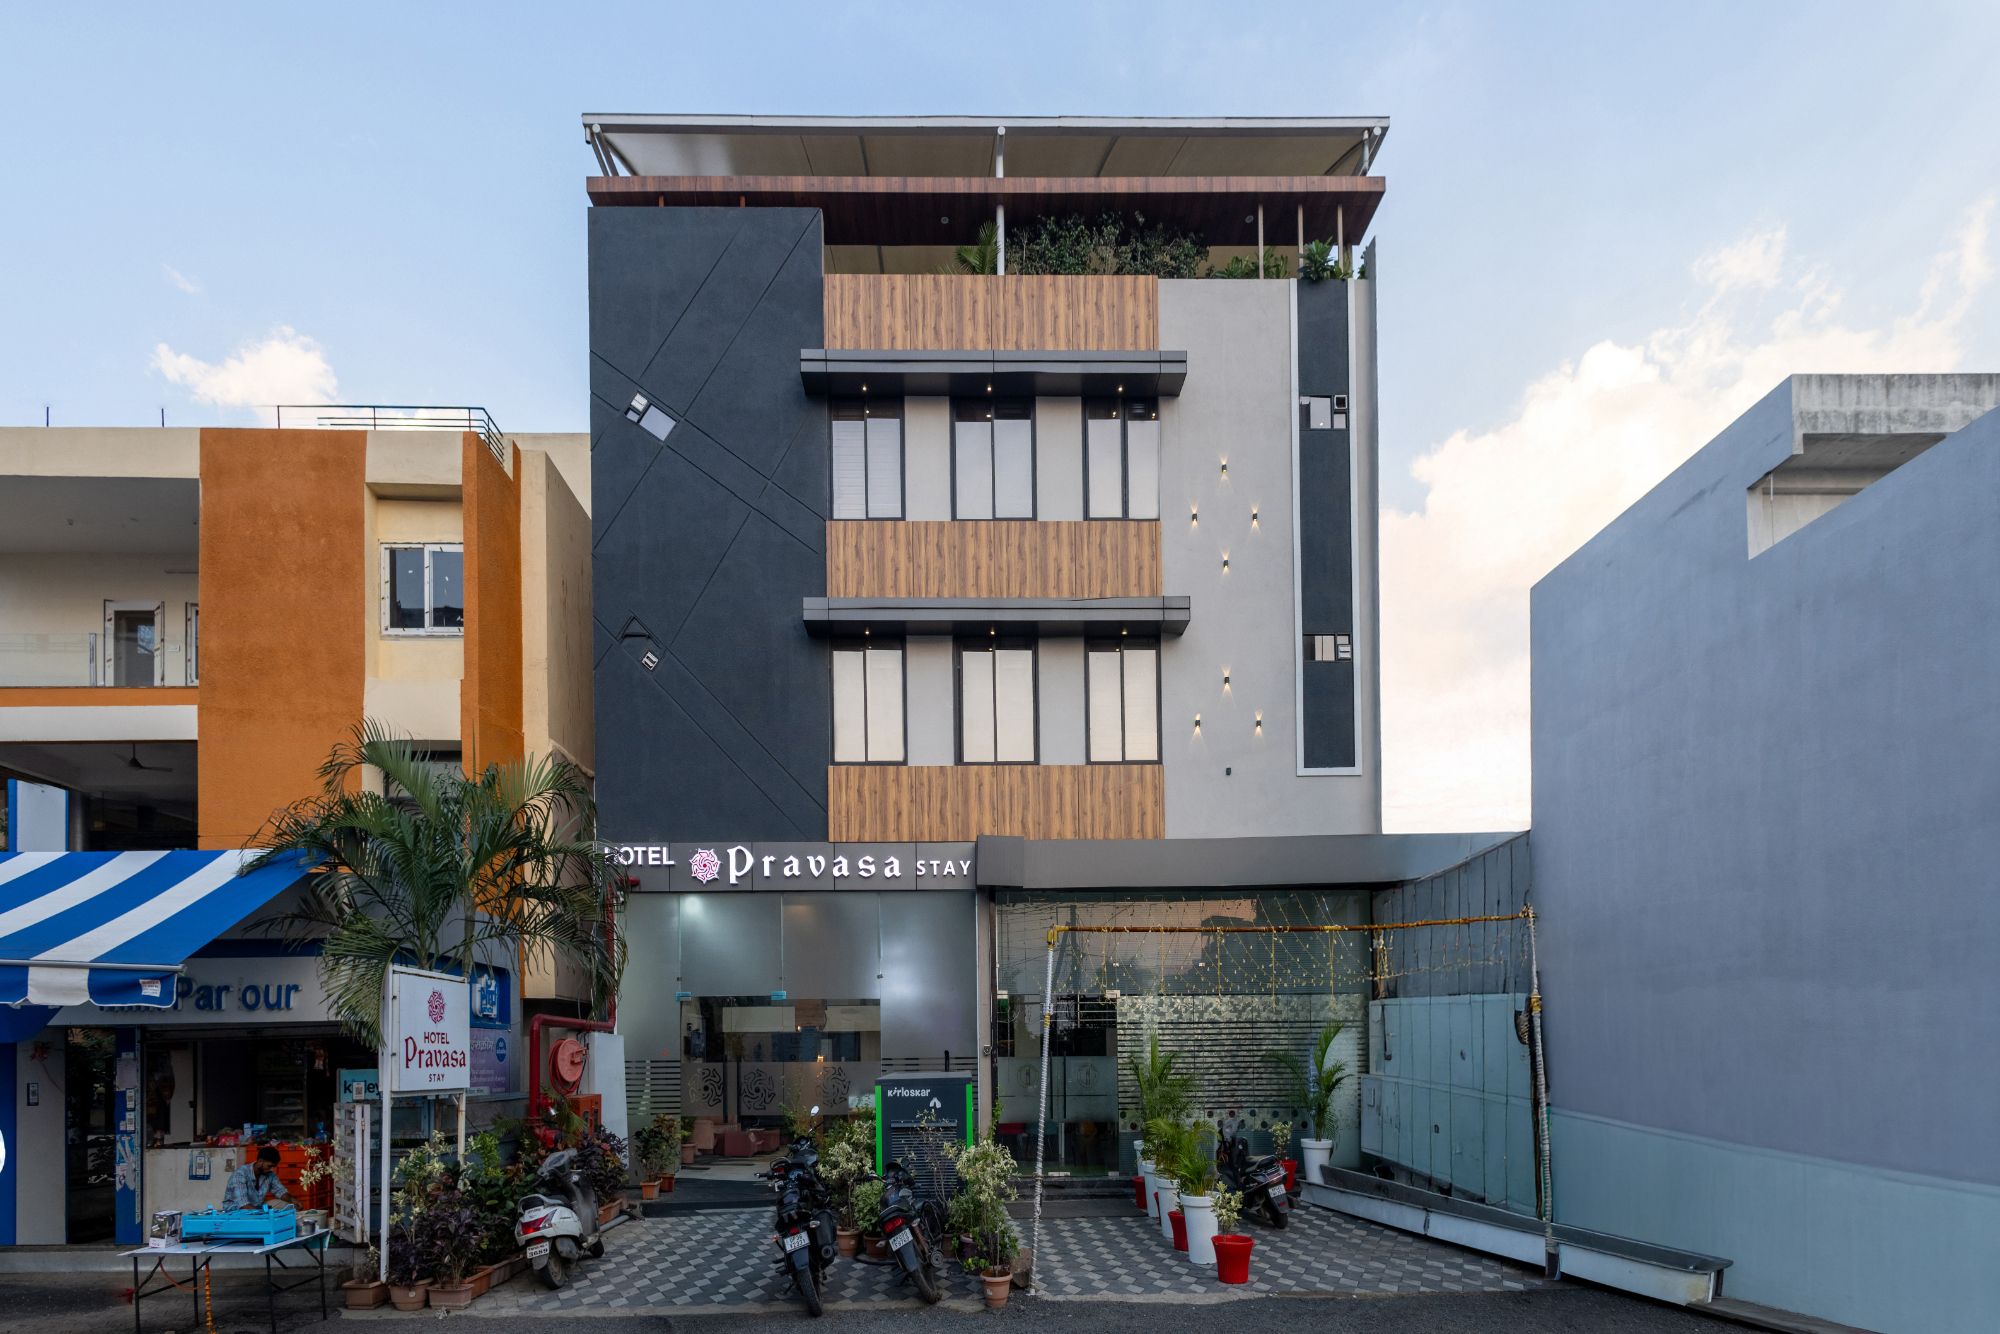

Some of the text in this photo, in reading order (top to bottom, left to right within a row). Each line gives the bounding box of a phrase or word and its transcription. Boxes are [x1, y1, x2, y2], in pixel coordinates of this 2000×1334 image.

[727, 845, 902, 884] Pravasa
[916, 860, 971, 876] STAY
[423, 1032, 450, 1044] HOTEL
[404, 1036, 467, 1068] Pravasa
[428, 1073, 446, 1082] STAY
